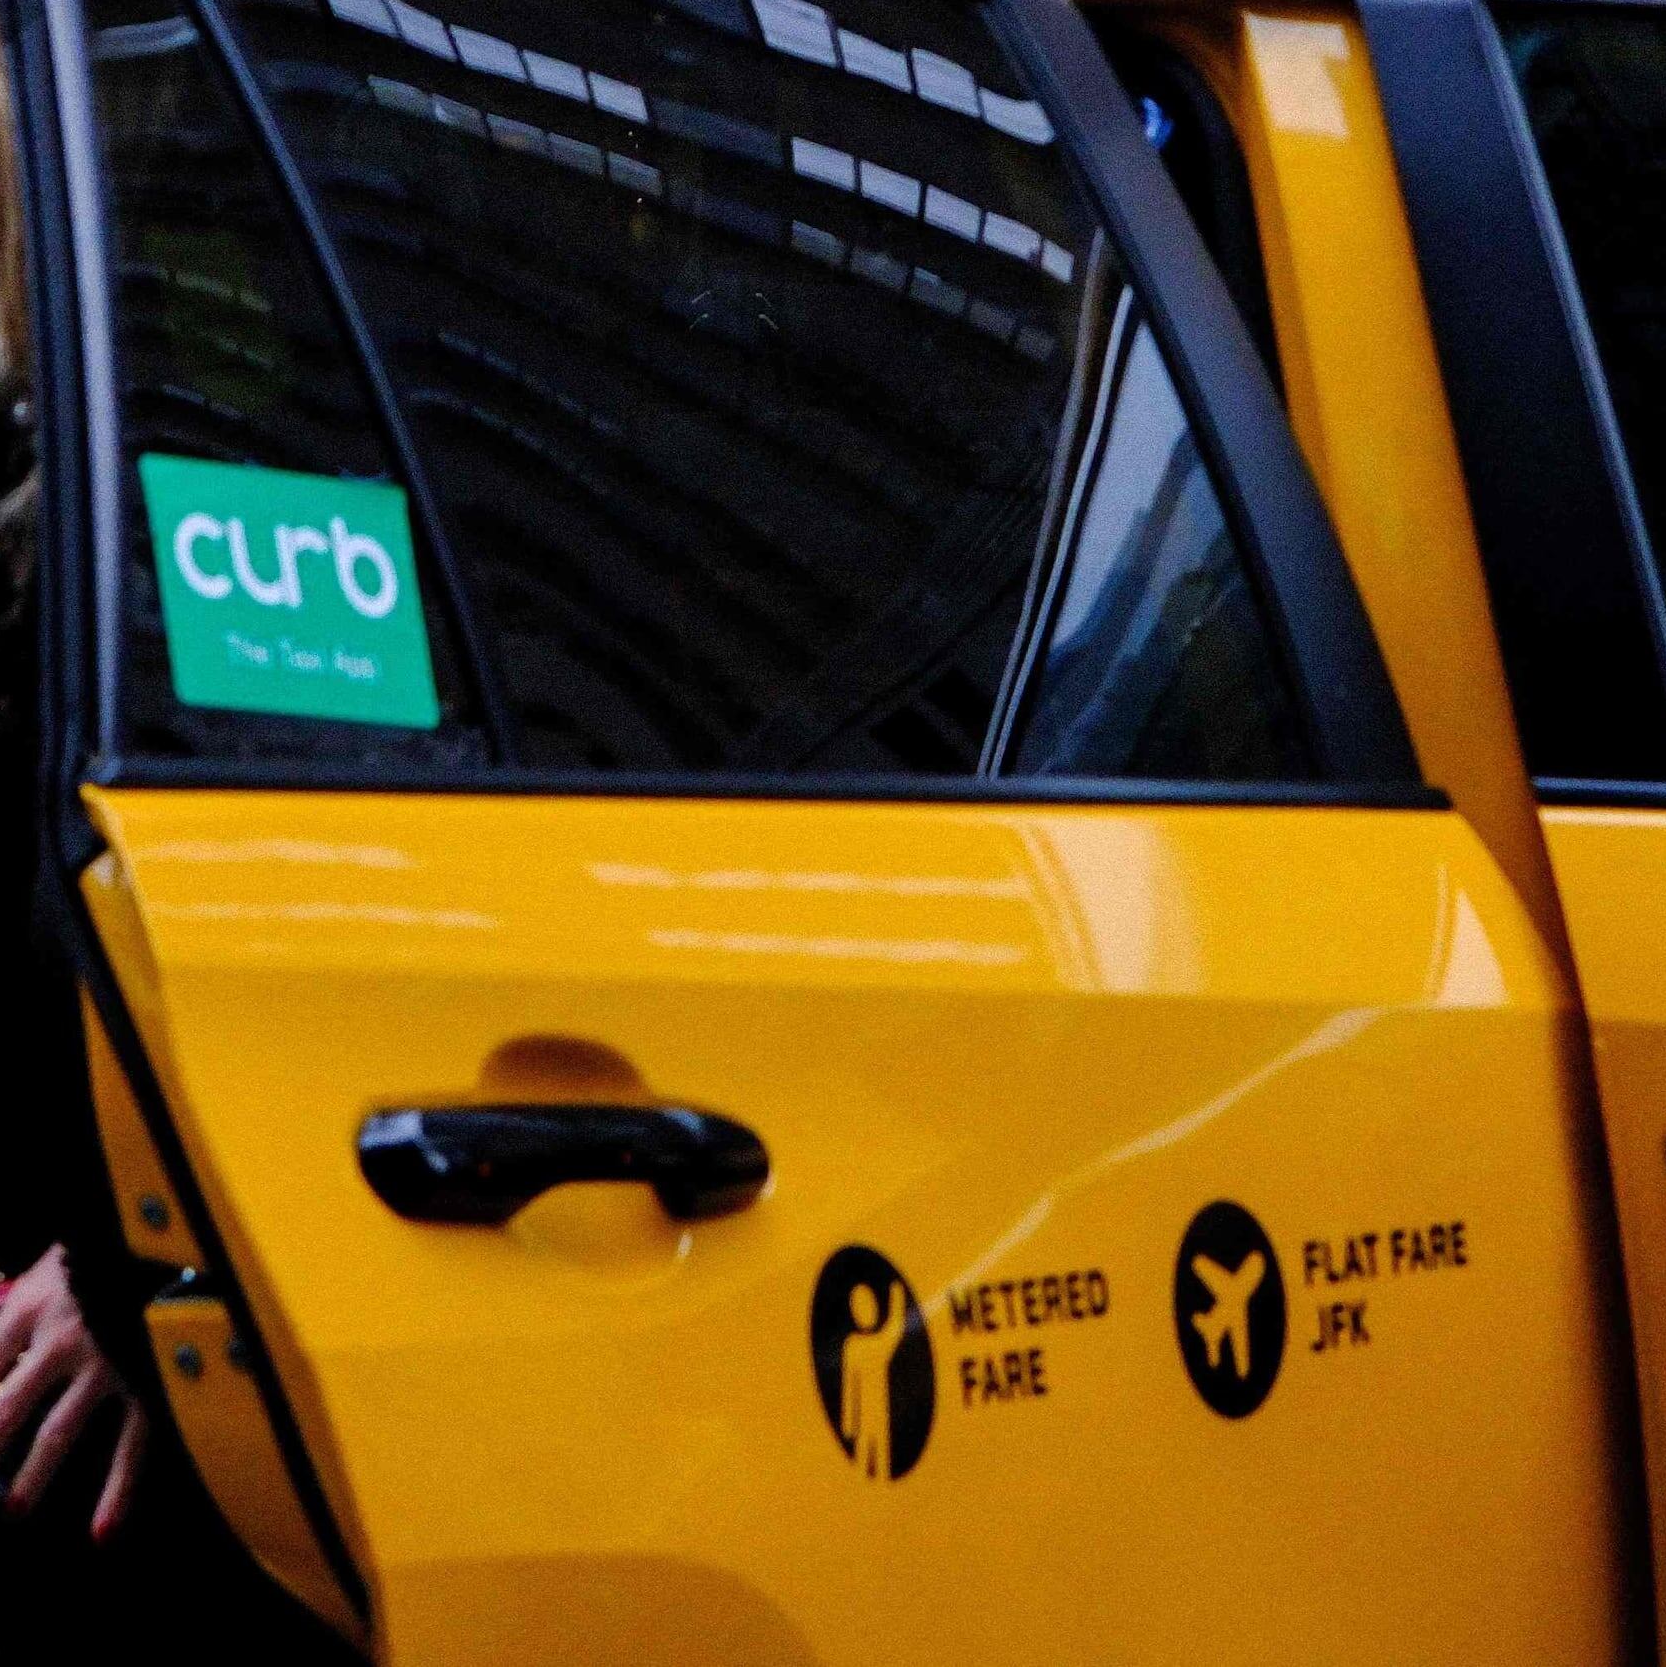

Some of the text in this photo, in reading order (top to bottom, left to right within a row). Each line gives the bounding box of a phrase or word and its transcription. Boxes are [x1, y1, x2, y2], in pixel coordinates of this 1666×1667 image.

[173, 512, 399, 619] curb
[1302, 1219, 1469, 1287] FLAT FARE
[949, 1267, 1111, 1336] METERED
[1309, 1300, 1371, 1354] JFK
[959, 1347, 1049, 1407] FARE
